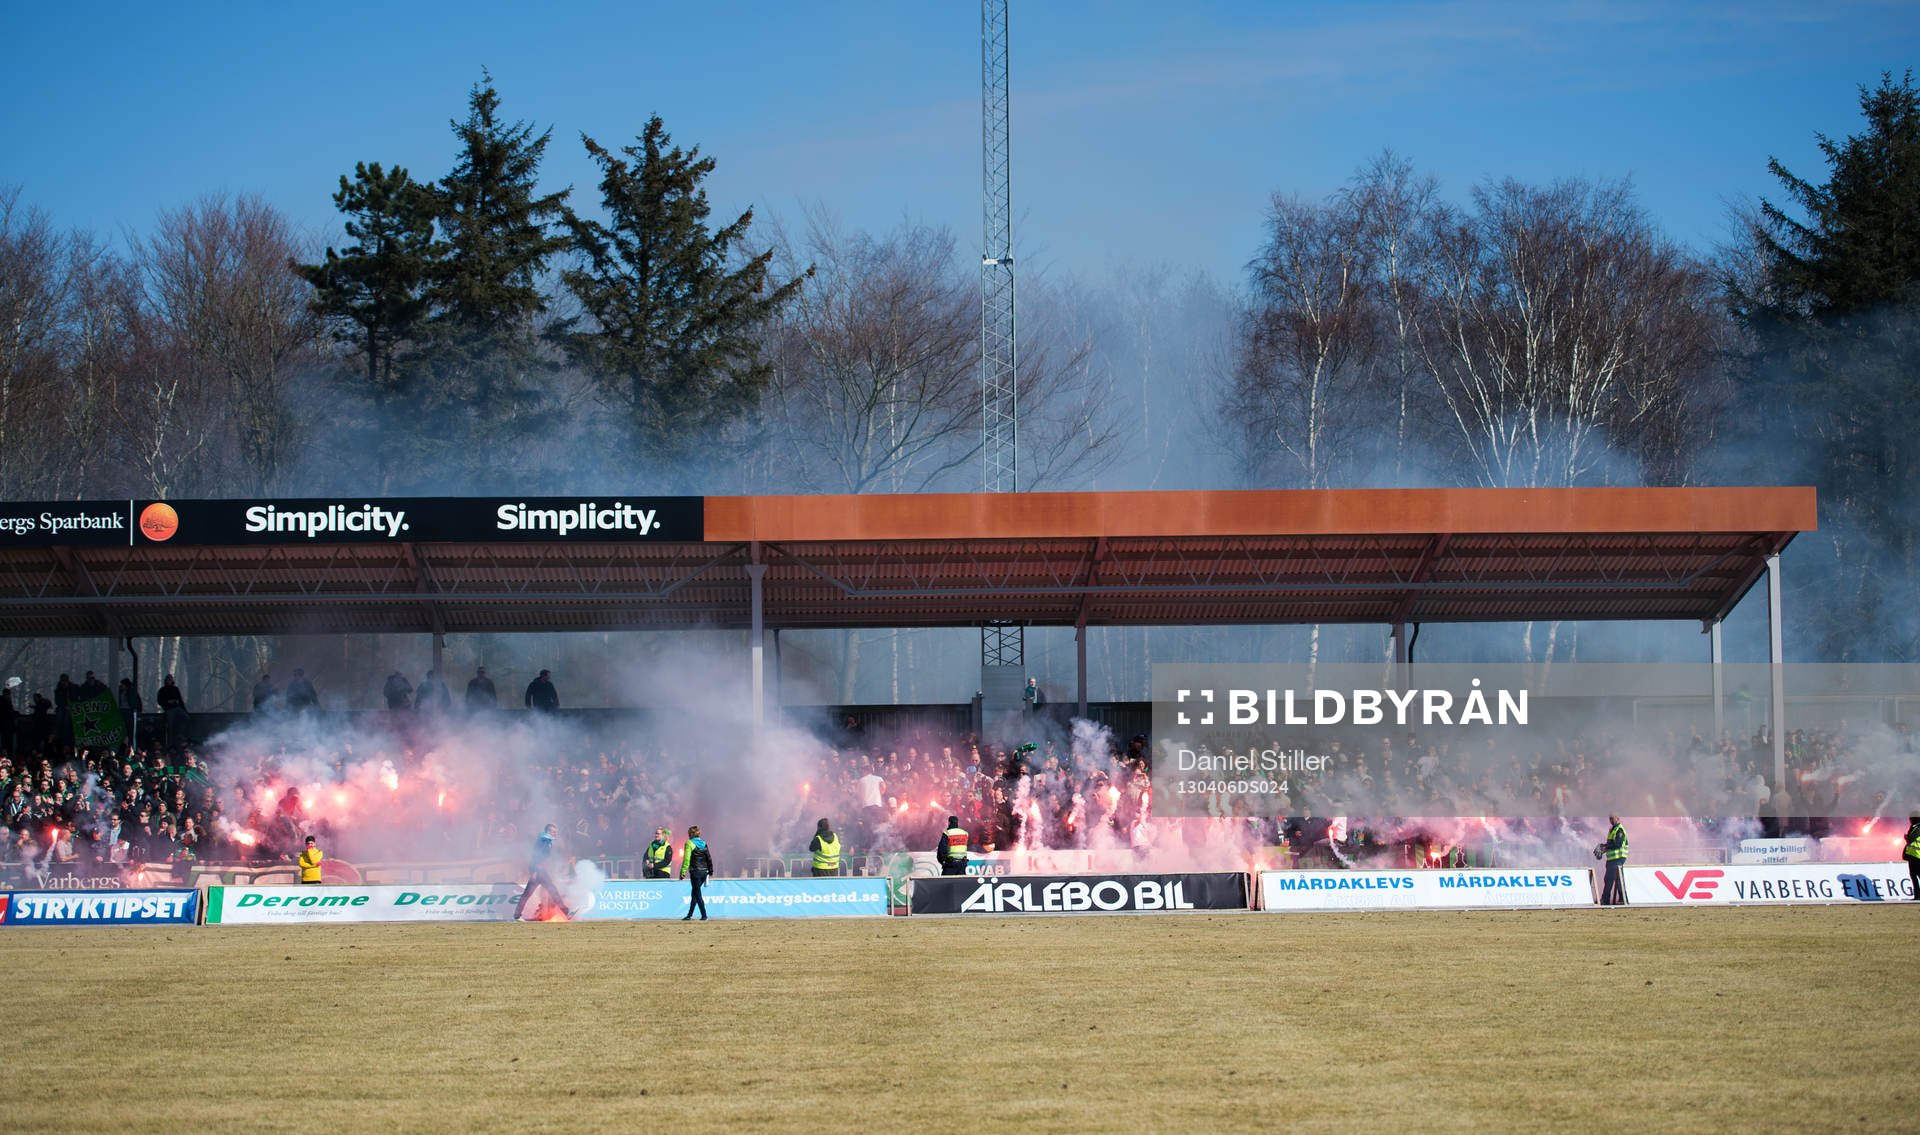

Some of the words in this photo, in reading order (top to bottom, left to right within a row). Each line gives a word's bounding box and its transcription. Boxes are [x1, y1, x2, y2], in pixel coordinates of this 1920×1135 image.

[39, 512, 125, 534] Sparbank
[245, 504, 410, 537] Simplicity.
[497, 502, 661, 536] Simplicity.
[36, 872, 121, 890] Varbergs
[1280, 875, 1414, 890] MÅRDAKLEVS
[1439, 873, 1573, 888] MÅRDAKLEVS
[1734, 879, 1833, 900] VARBERG
[1841, 878, 1914, 898] ENERG
[236, 893, 370, 908] Derome
[599, 890, 664, 900] VARBERGS
[961, 877, 1129, 913] ÄRLEBO
[1134, 880, 1194, 910] BIL
[15, 897, 188, 919] STRYKTIPSET
[599, 900, 650, 911] BOSTAD
